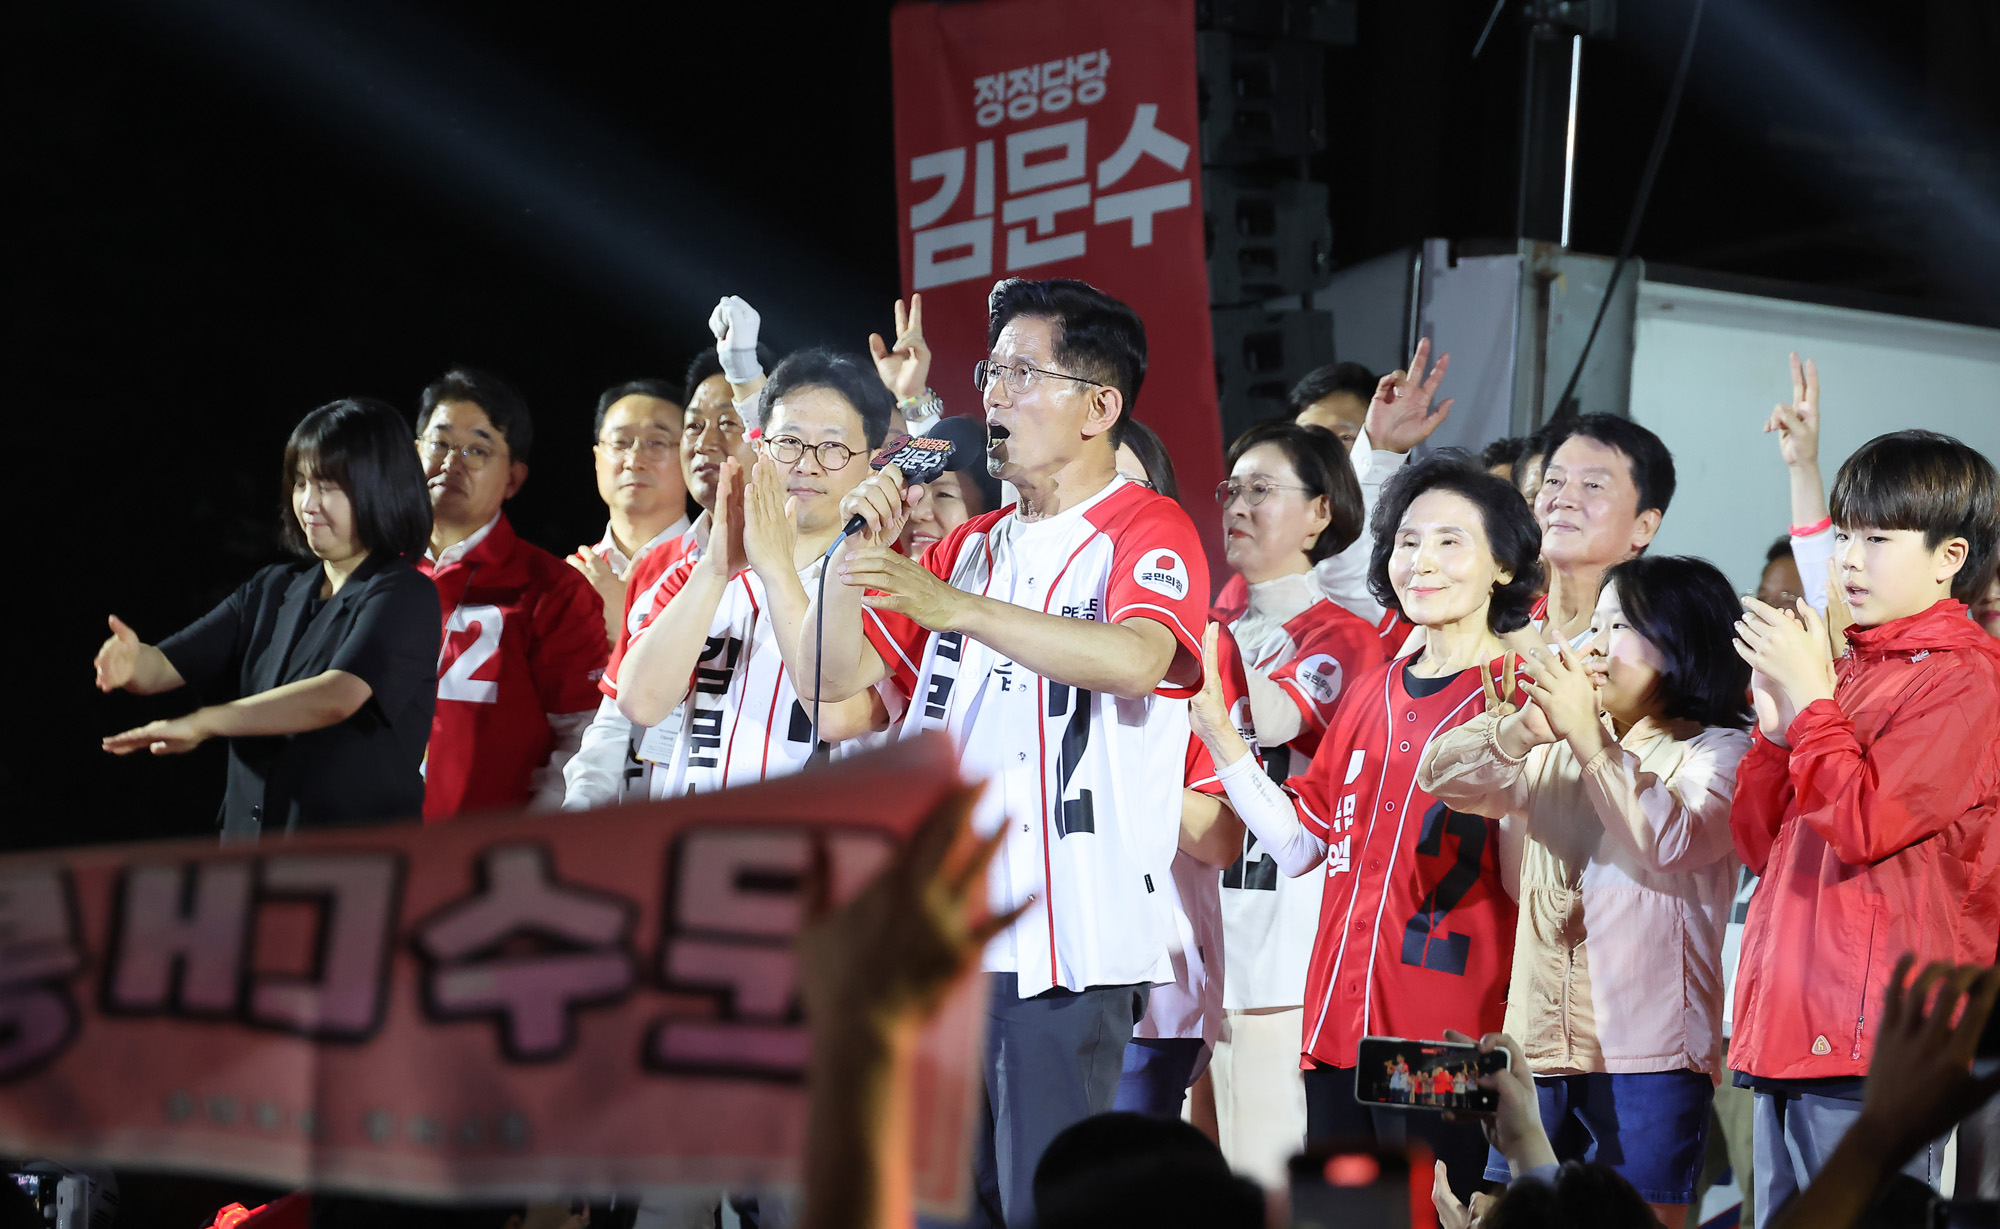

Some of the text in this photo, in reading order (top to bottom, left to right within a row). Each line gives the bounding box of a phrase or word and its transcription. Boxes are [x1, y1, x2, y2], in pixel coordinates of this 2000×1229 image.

[973, 48, 1111, 128] 정정당당
[910, 103, 1192, 290] 김문수
[1141, 572, 1183, 594] 국민의힘
[437, 603, 504, 704] 2
[1401, 799, 1488, 977] 2
